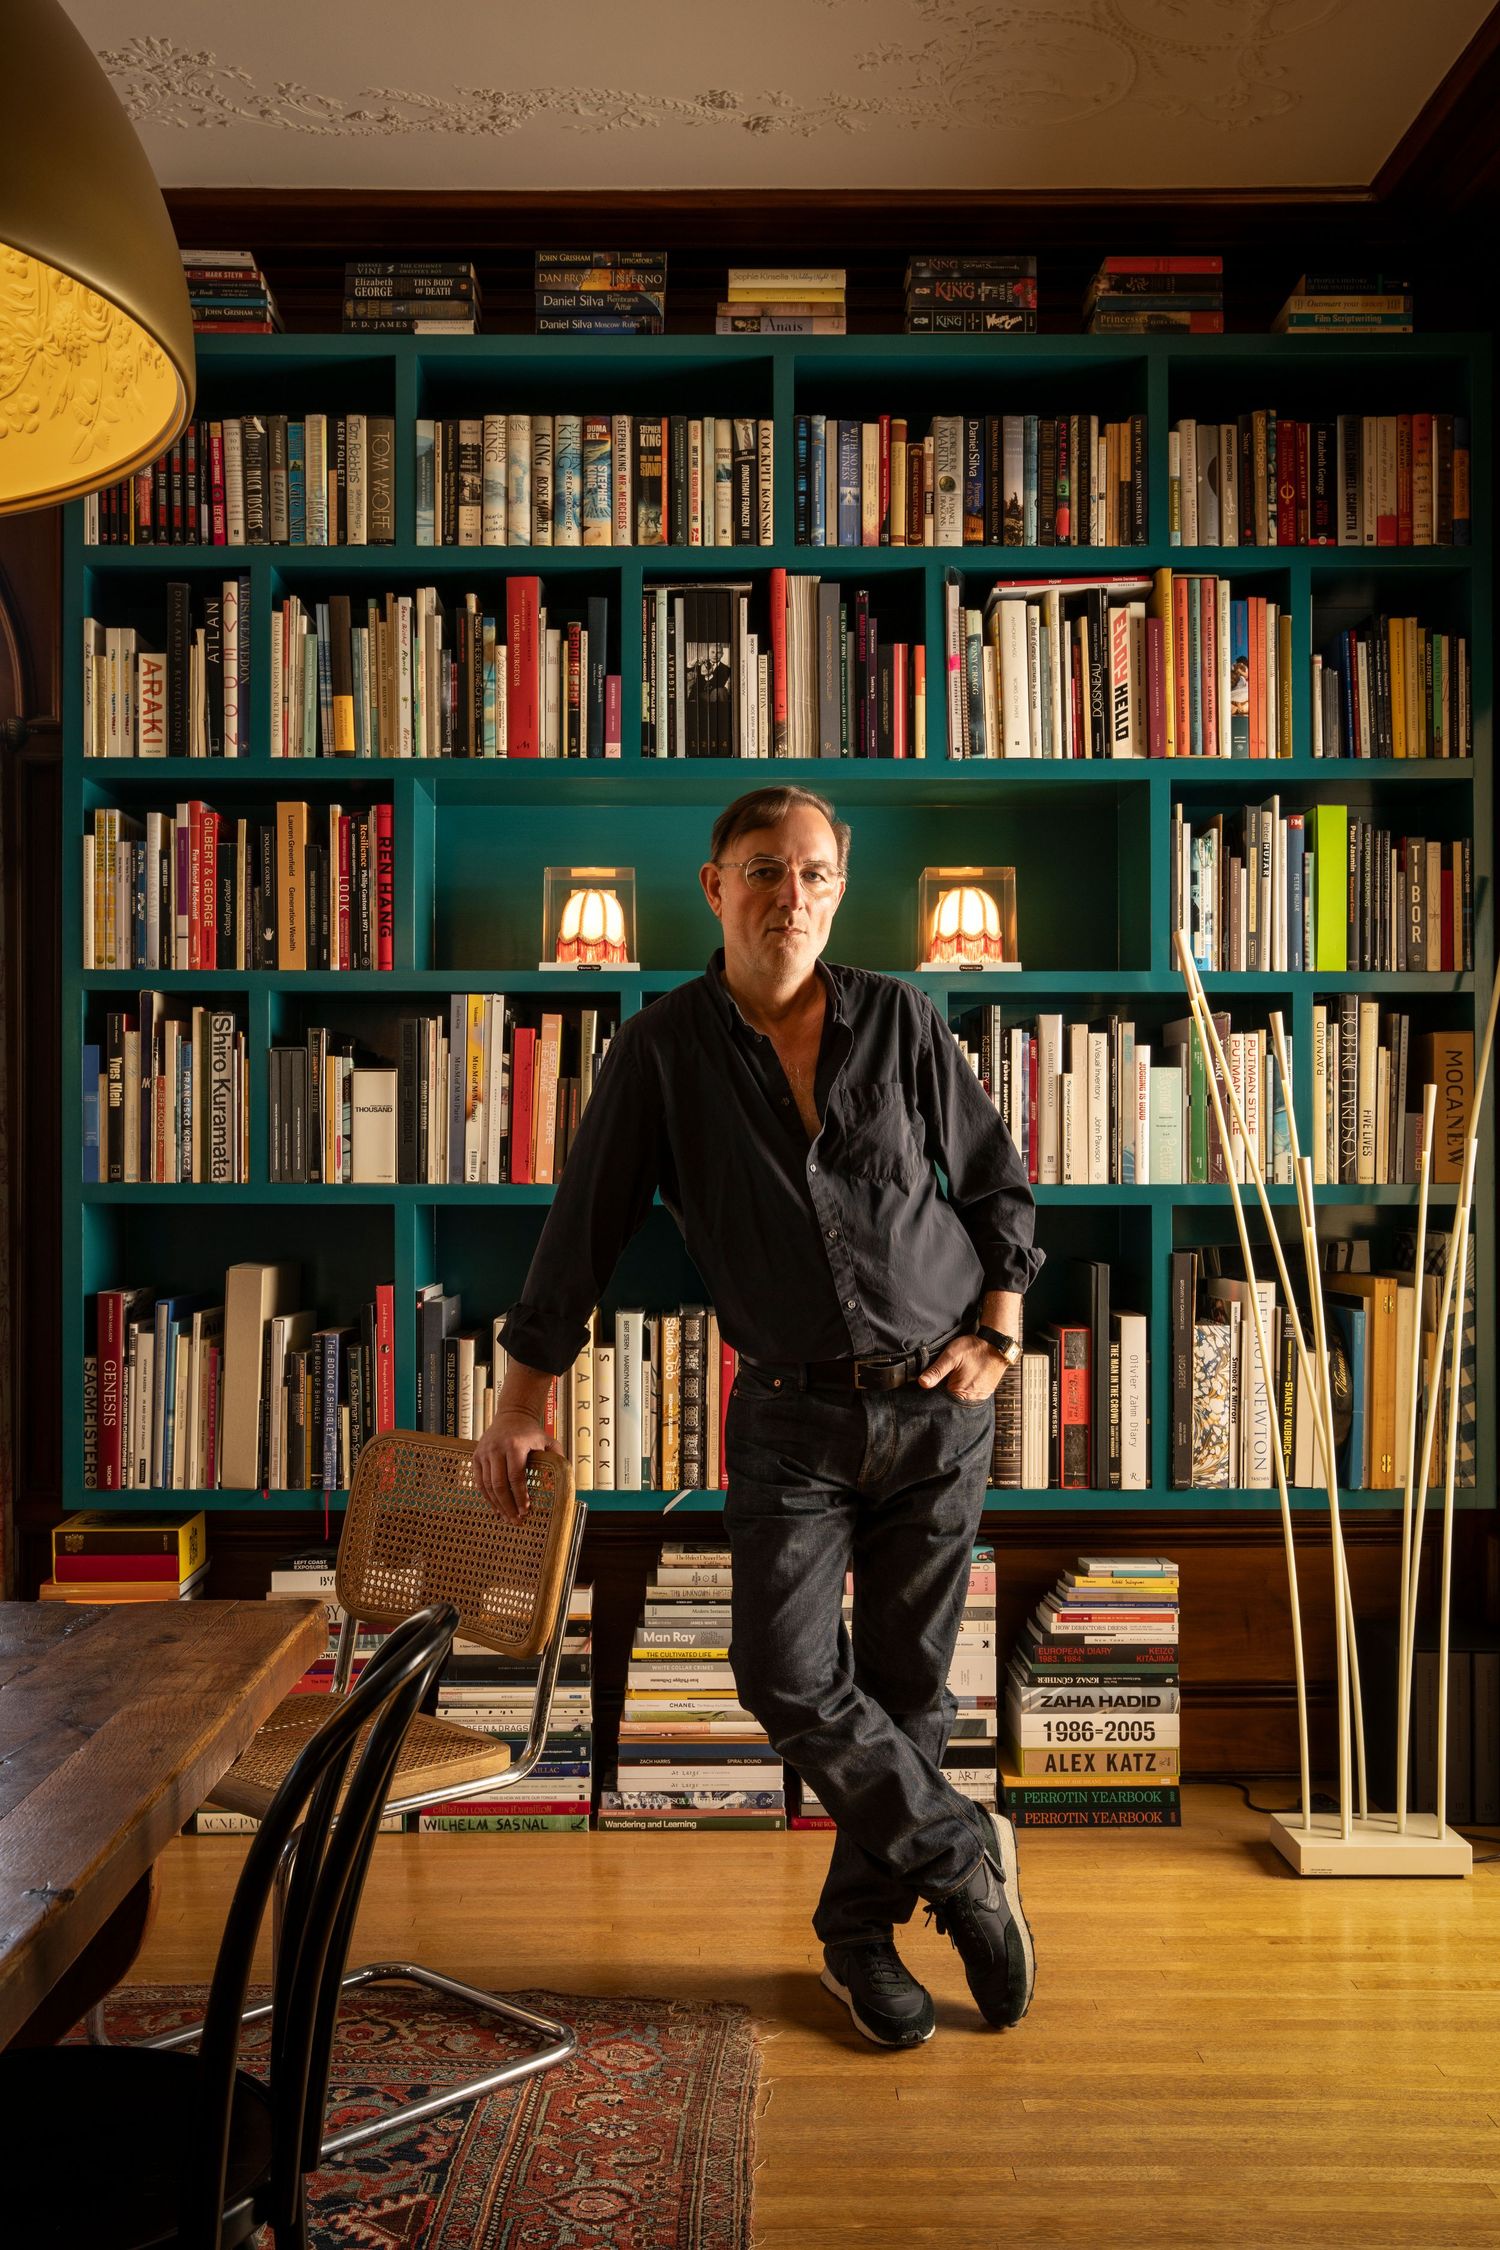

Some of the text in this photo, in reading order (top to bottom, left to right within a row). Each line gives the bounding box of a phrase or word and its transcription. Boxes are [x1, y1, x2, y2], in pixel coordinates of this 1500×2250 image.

[539, 253, 590, 262] JOHN GRISHAM
[539, 273, 560, 284] DAN
[355, 277, 393, 287] Elizabeth
[355, 287, 393, 297] GEORGE
[414, 279, 453, 288] THIS BODY
[415, 288, 451, 296] OF DEATH
[543, 295, 604, 306] Daniel Silva
[936, 282, 976, 301] KING
[539, 319, 640, 329] Daniel Silva Moscow Rules
[936, 315, 961, 327] KING
[1100, 315, 1148, 323] Princesses
[348, 418, 361, 483] Tom Robbins
[485, 420, 497, 463] KING
[498, 420, 507, 463] STEPHEN
[535, 433, 550, 466] KING
[558, 424, 571, 469] KING
[587, 425, 607, 433] DUMA
[617, 420, 626, 471] STEPHEN KING
[640, 434, 661, 447] KING
[938, 428, 948, 472] MARTIN
[968, 421, 979, 477] Daniel Silva
[1257, 416, 1265, 476] Selfridges
[337, 421, 345, 487] KEN FOLLETT
[842, 432, 850, 480] AS WITNESS
[1317, 431, 1326, 495] Elizabeth George
[372, 432, 390, 528] TOM WOLFE
[587, 465, 597, 488] KING
[598, 465, 607, 508] STEPHEN
[741, 464, 750, 527] JONATHAN FRANZEN
[761, 427, 771, 539] COCKPIT KOSINSKI
[1346, 453, 1356, 530] CORNWELL SCARPETTA
[247, 470, 263, 529] NICK TOSCHES
[274, 475, 284, 522] LEAVING
[537, 476, 548, 532] ROSE MADDER
[618, 491, 627, 529] MERCEDES
[207, 602, 219, 664] ATLAN
[240, 582, 250, 685] VERSACE/AVEDON
[143, 658, 162, 743] ARAKI
[971, 665, 979, 695] CRAGG
[1092, 664, 1102, 717] DOISNEAU
[1115, 683, 1129, 741] HELLO
[204, 818, 212, 865] GILBERT
[204, 879, 213, 927] GEORGE
[339, 876, 349, 912] LOOK
[379, 837, 391, 938] REN HANG
[1412, 845, 1421, 943] TIBOR
[109, 1057, 122, 1107] Yves Klein
[213, 1018, 231, 1179] Shiro Kuramata
[1342, 1011, 1356, 1167] BOB RICHARDSON
[545, 1076, 556, 1144] MAPPLETHORPE
[1446, 1050, 1464, 1167] MOCA NEW
[1363, 1110, 1372, 1156] FIVE LIVES
[327, 1358, 335, 1380] BOOK
[1110, 1344, 1119, 1357] THE
[1110, 1359, 1119, 1374] MAN
[1231, 1357, 1239, 1386] Smoke
[104, 1360, 116, 1426] GENESIS
[327, 1383, 334, 1394] OF
[351, 1389, 359, 1422] Shulman:
[1111, 1385, 1119, 1397] THE
[1129, 1355, 1139, 1447] Olivier Zahm Diary
[84, 1362, 96, 1473] SAGMEISTER
[1110, 1399, 1119, 1424] CROWD
[1254, 1382, 1267, 1470] NEWTON
[1283, 1382, 1293, 1455] STANLEY KUBRICK
[644, 1632, 695, 1644] Man Ray
[1041, 1696, 1161, 1707] ZAHA HADID
[1045, 1754, 1156, 1772] ALEX KATZ
[1024, 1791, 1162, 1803] PERROTIN YEARBOOK
[1025, 1812, 1162, 1824] PERROTIN YEARBOOK
[424, 1819, 548, 1831] WILHELM SASNAL
[605, 1821, 646, 1829] Wandering
[663, 1820, 696, 1829] Learning
